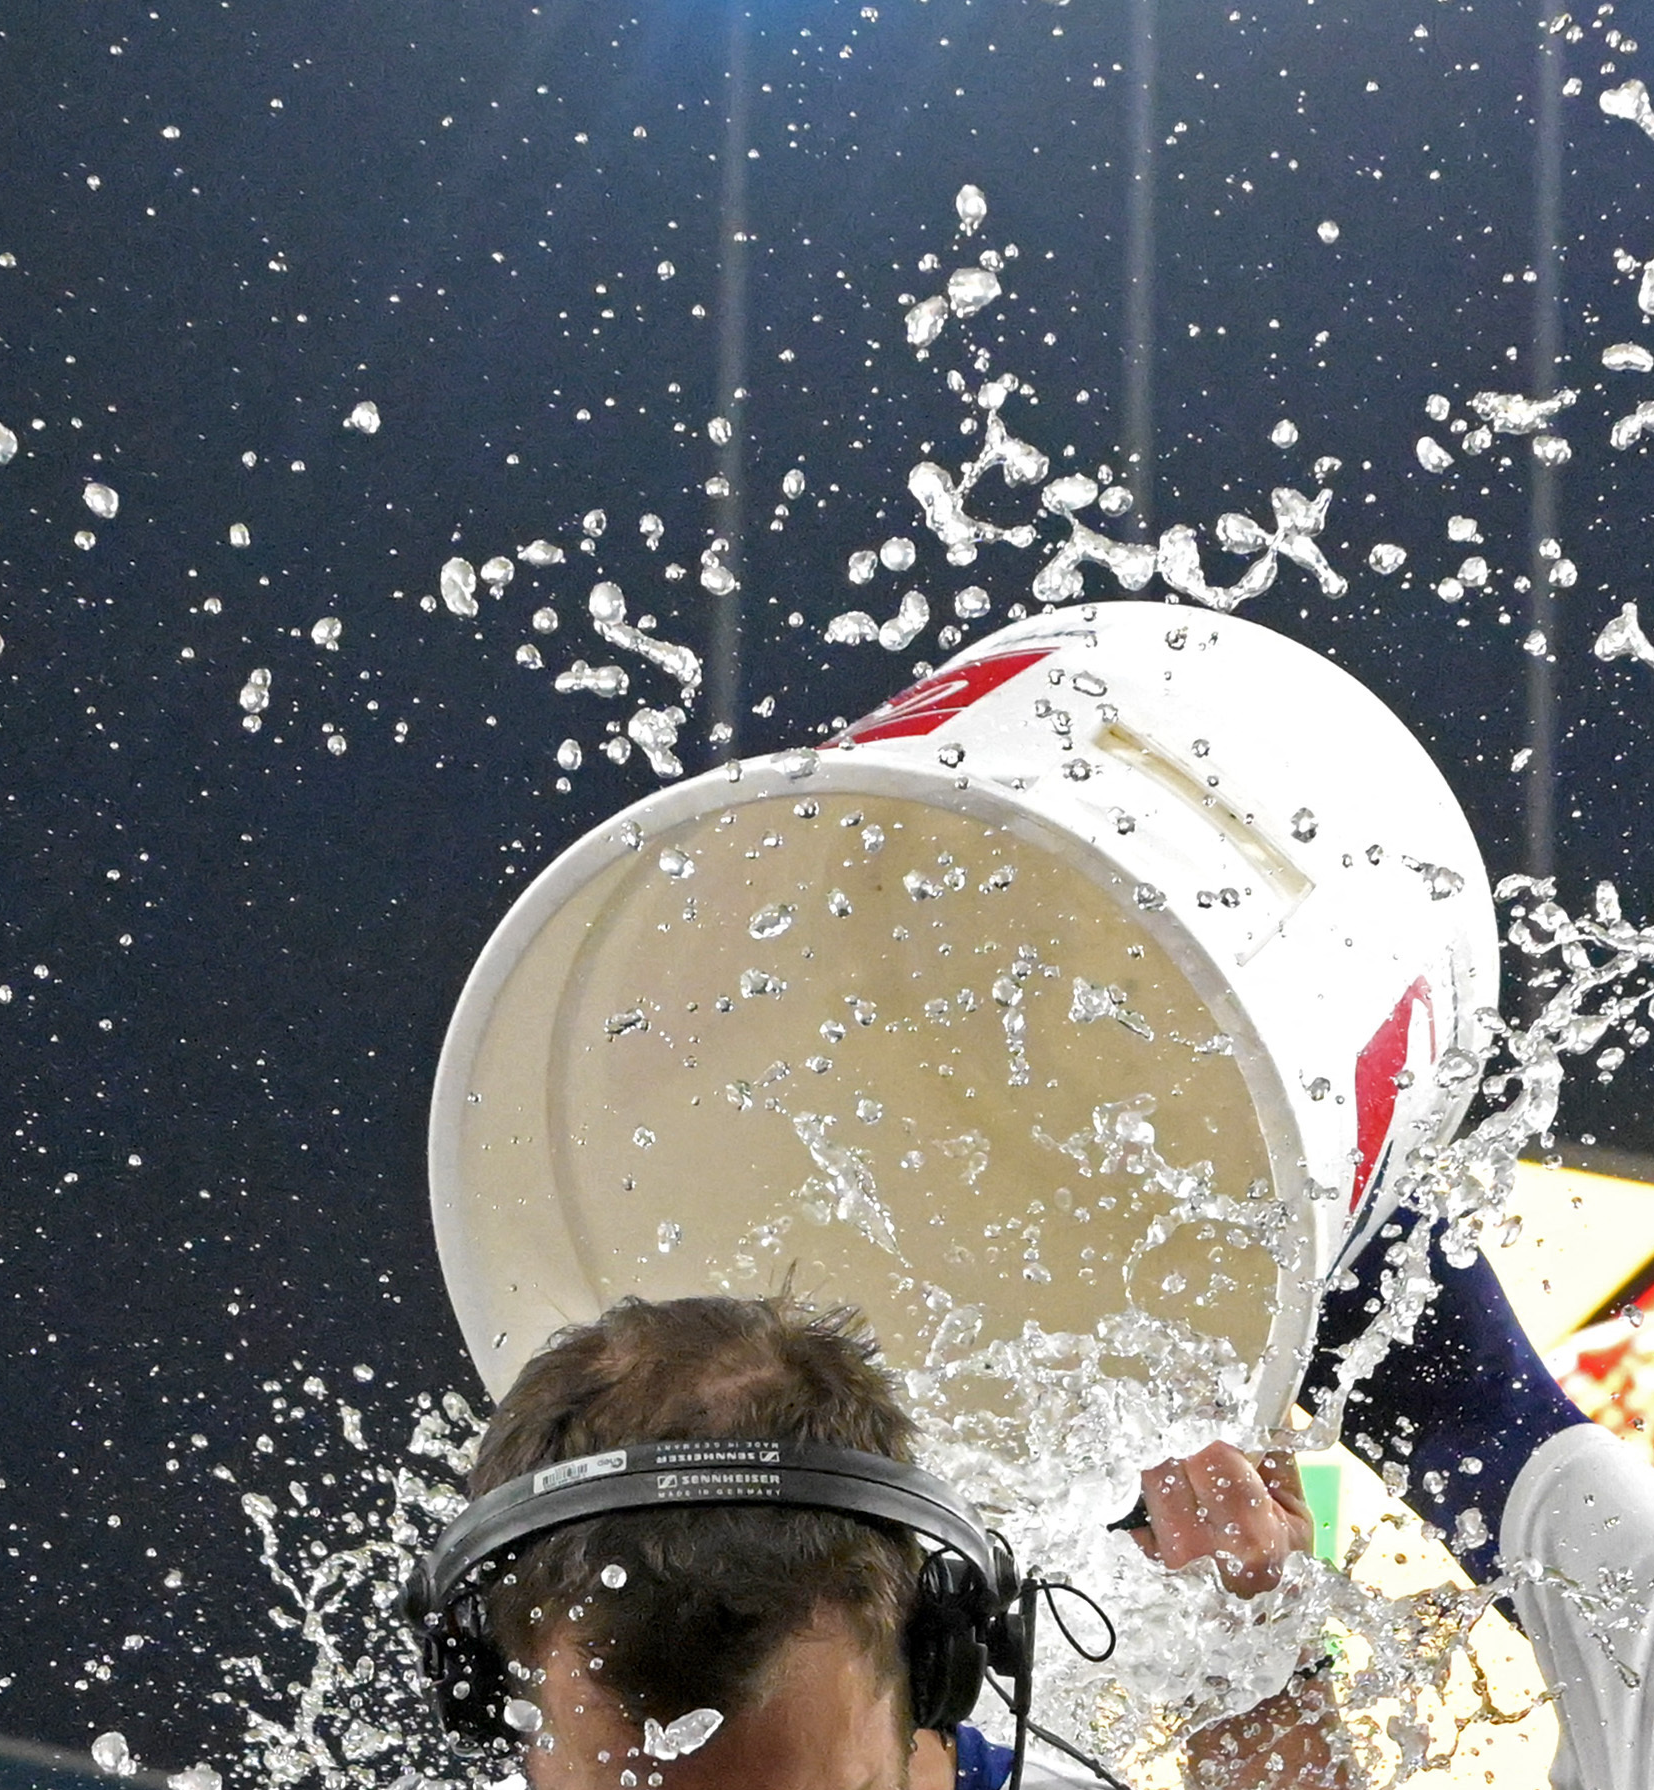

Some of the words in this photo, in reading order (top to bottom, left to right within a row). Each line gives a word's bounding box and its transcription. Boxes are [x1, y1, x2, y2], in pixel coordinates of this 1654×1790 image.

[656, 1452, 756, 1464] SENNHEISER
[681, 1474, 781, 1485] SENNHEISER
[658, 1490, 691, 1498] MADE
[716, 1488, 781, 1496] GERMANY
